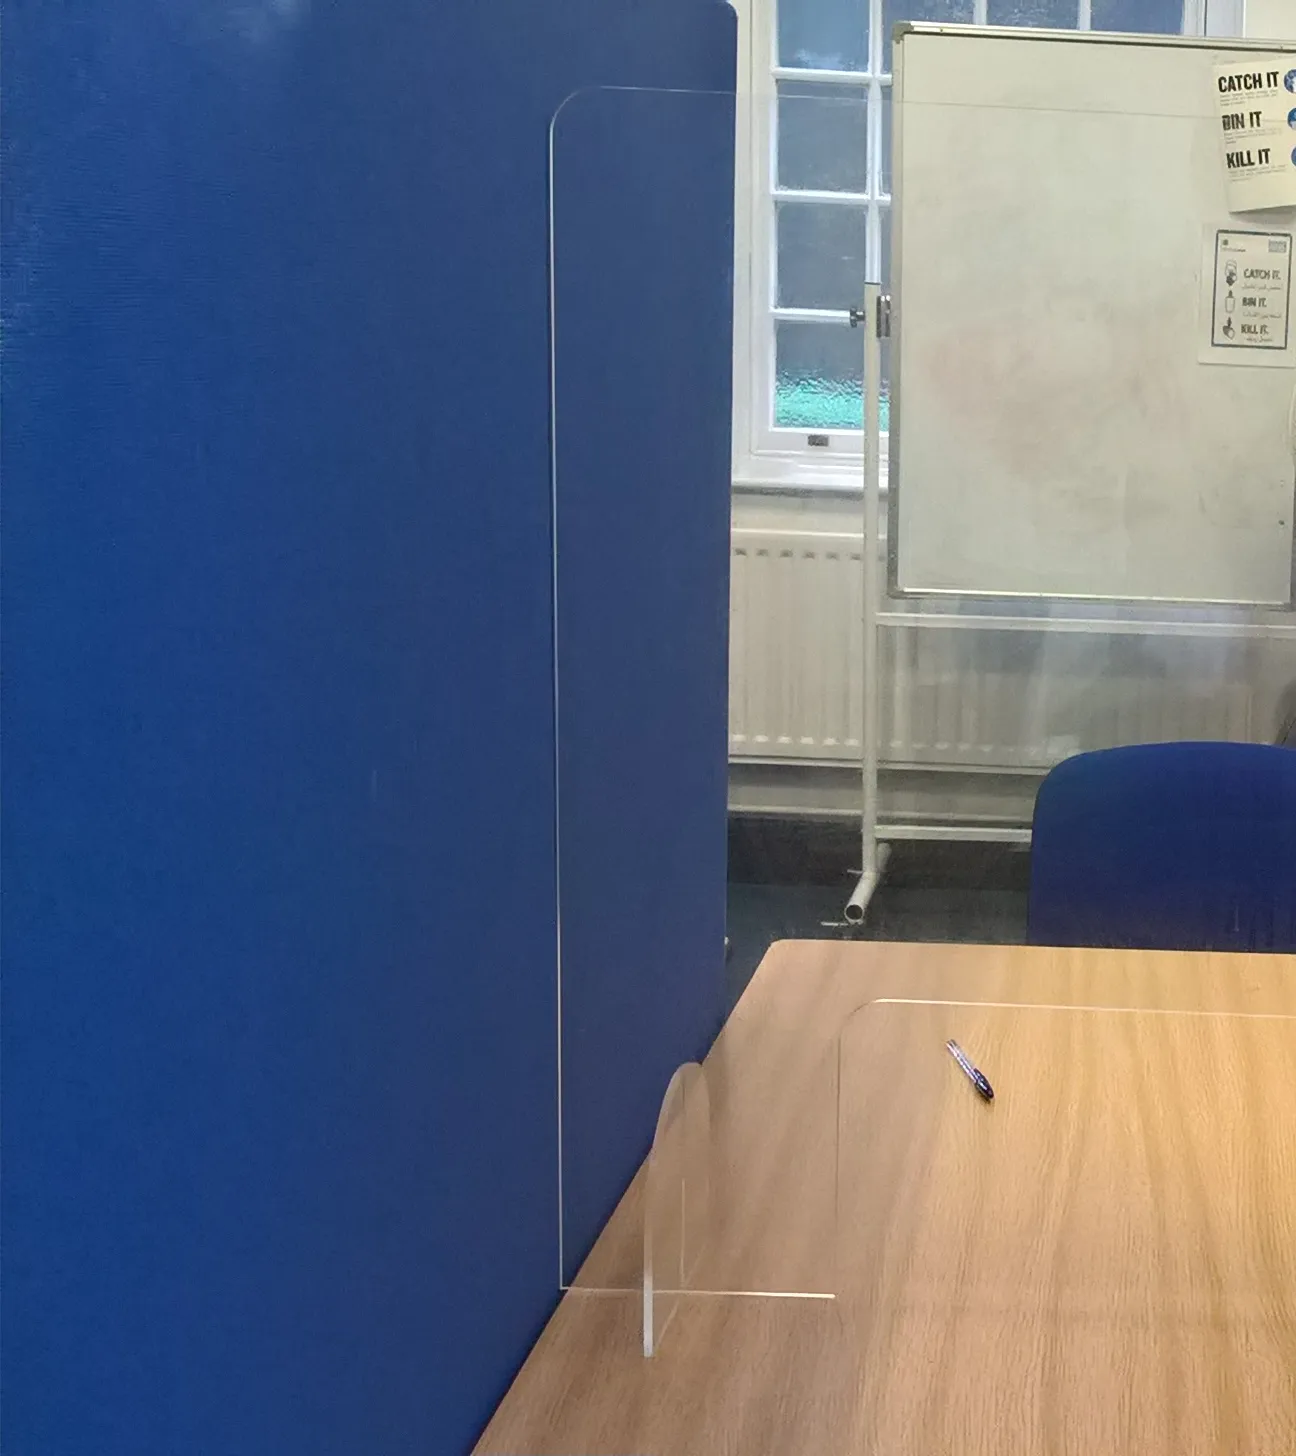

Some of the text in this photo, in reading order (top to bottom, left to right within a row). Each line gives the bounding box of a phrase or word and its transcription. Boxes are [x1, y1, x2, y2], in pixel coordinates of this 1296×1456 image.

[1218, 71, 1279, 93] CATCH IT
[1222, 111, 1262, 131] BIN IT
[1226, 148, 1271, 169] KILL IT
